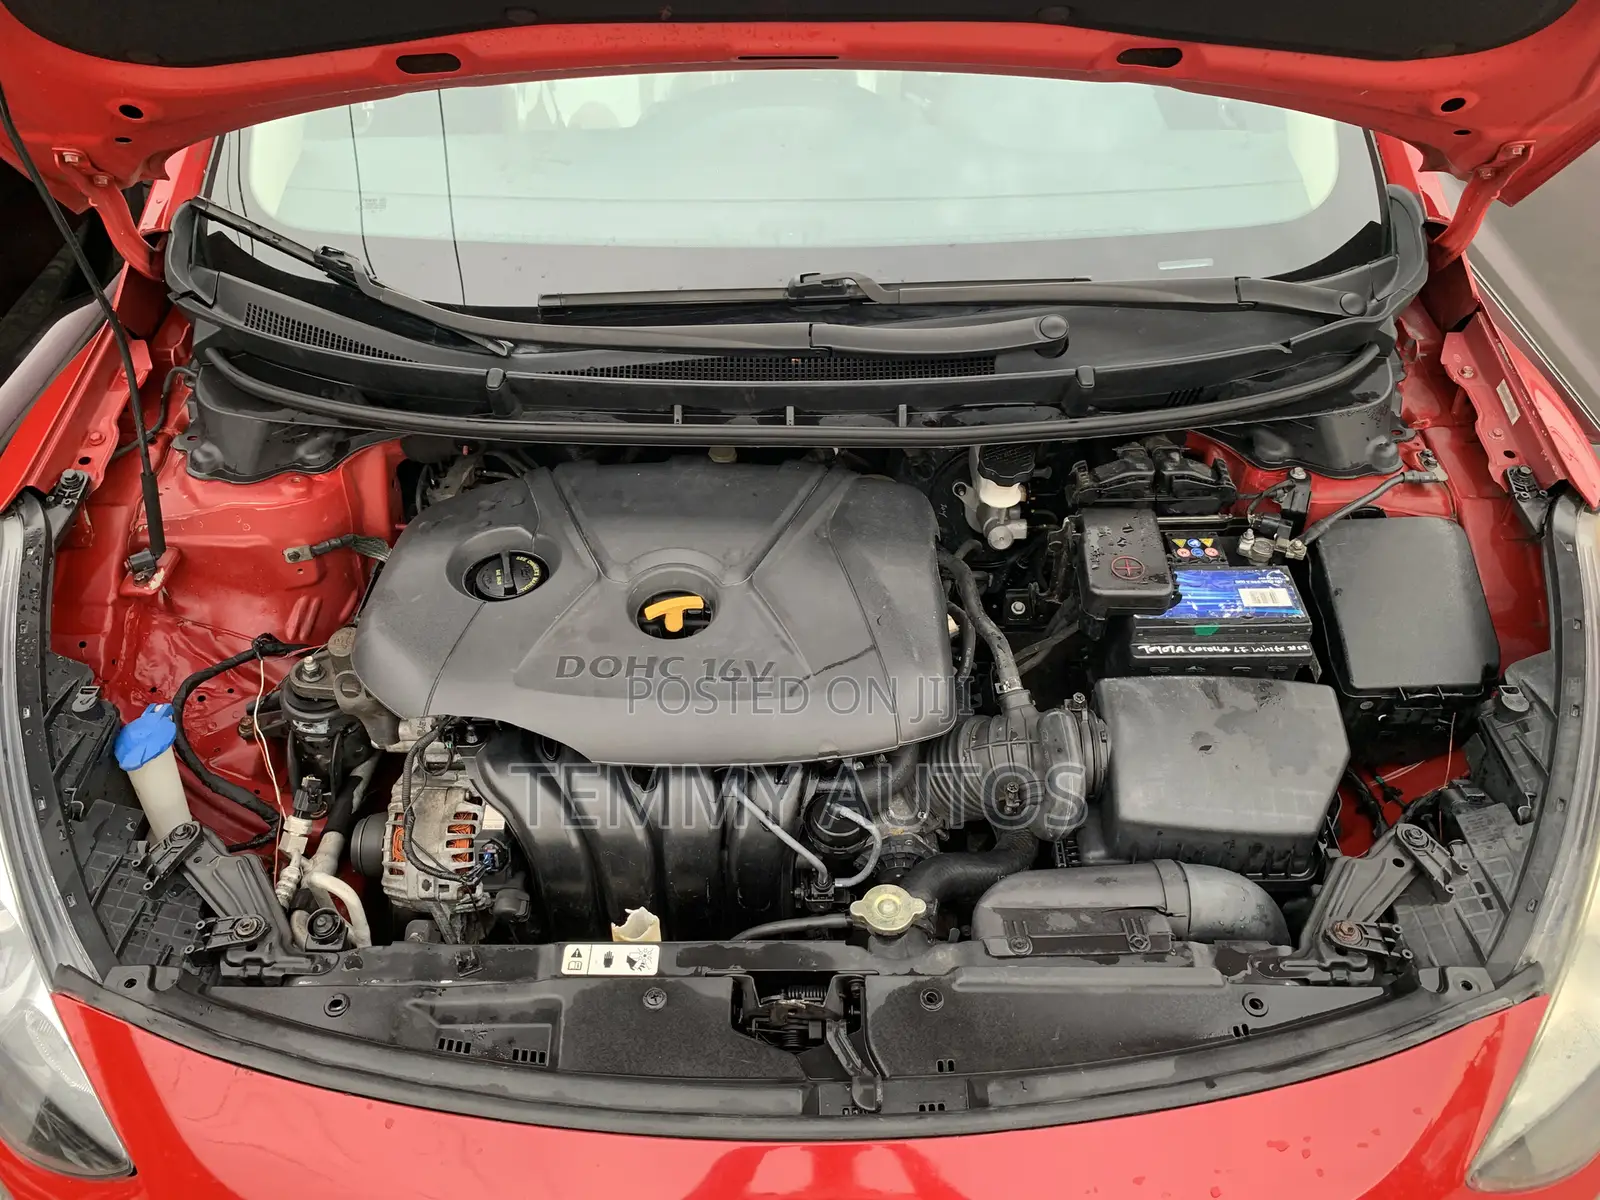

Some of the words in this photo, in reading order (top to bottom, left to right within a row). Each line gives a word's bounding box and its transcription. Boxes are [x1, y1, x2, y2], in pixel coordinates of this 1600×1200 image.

[1137, 645, 1185, 654] TOYOTA
[555, 655, 685, 679] DOHC
[702, 658, 776, 682] 16V
